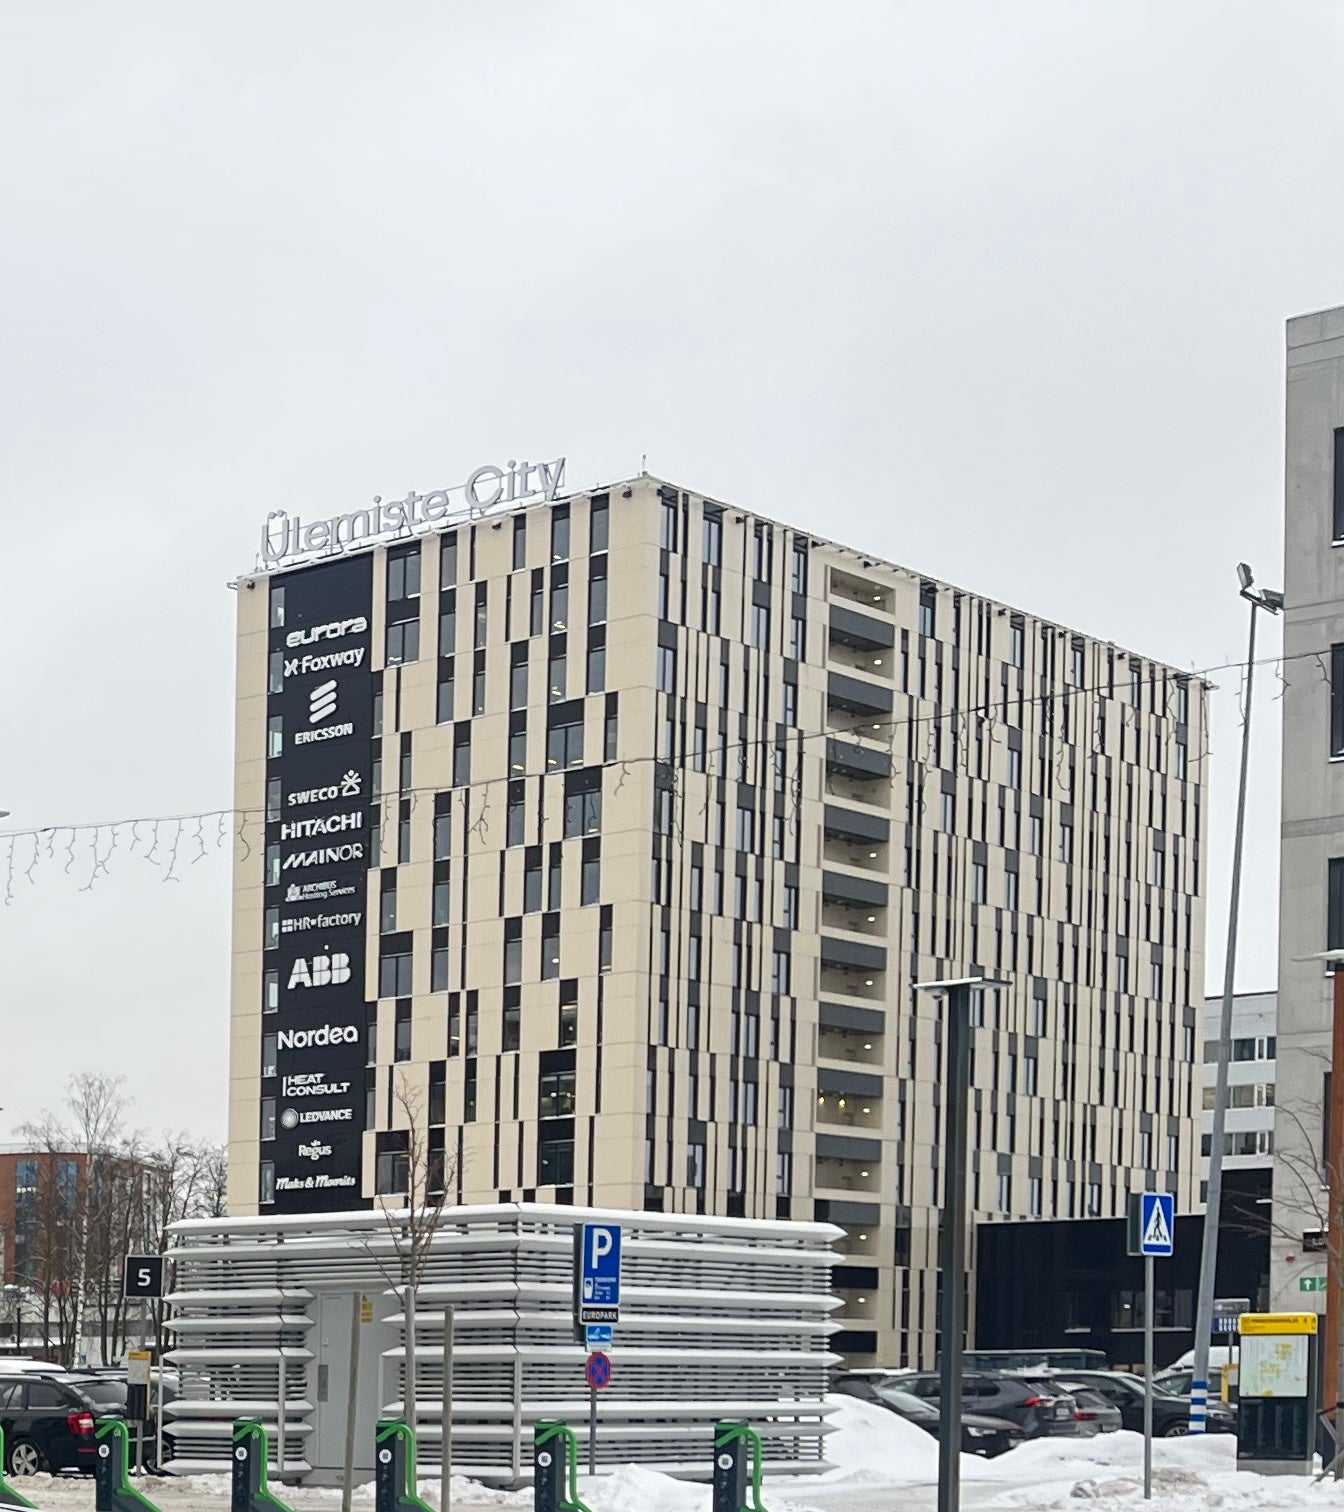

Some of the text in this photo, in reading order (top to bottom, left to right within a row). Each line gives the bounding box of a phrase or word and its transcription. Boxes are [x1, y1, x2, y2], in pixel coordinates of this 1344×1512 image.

[260, 457, 566, 562] Ülemiste City
[286, 616, 368, 648] eurora
[302, 647, 365, 674] Foxway
[295, 722, 354, 745] ERICSSON
[288, 786, 339, 806] SWECO
[281, 811, 363, 841] HITACHI
[282, 843, 364, 870] MAINOR
[287, 953, 351, 989] ABB
[277, 1024, 359, 1050] Nordea
[286, 1082, 351, 1097] CONSULT
[287, 1073, 326, 1086] HEAT
[299, 1108, 353, 1123] LEDVANCE
[298, 1144, 333, 1161] Regus
[304, 1176, 314, 1189] &
[592, 1228, 612, 1269] P
[137, 1268, 151, 1287] 5
[583, 1311, 618, 1320] EUROPARK
